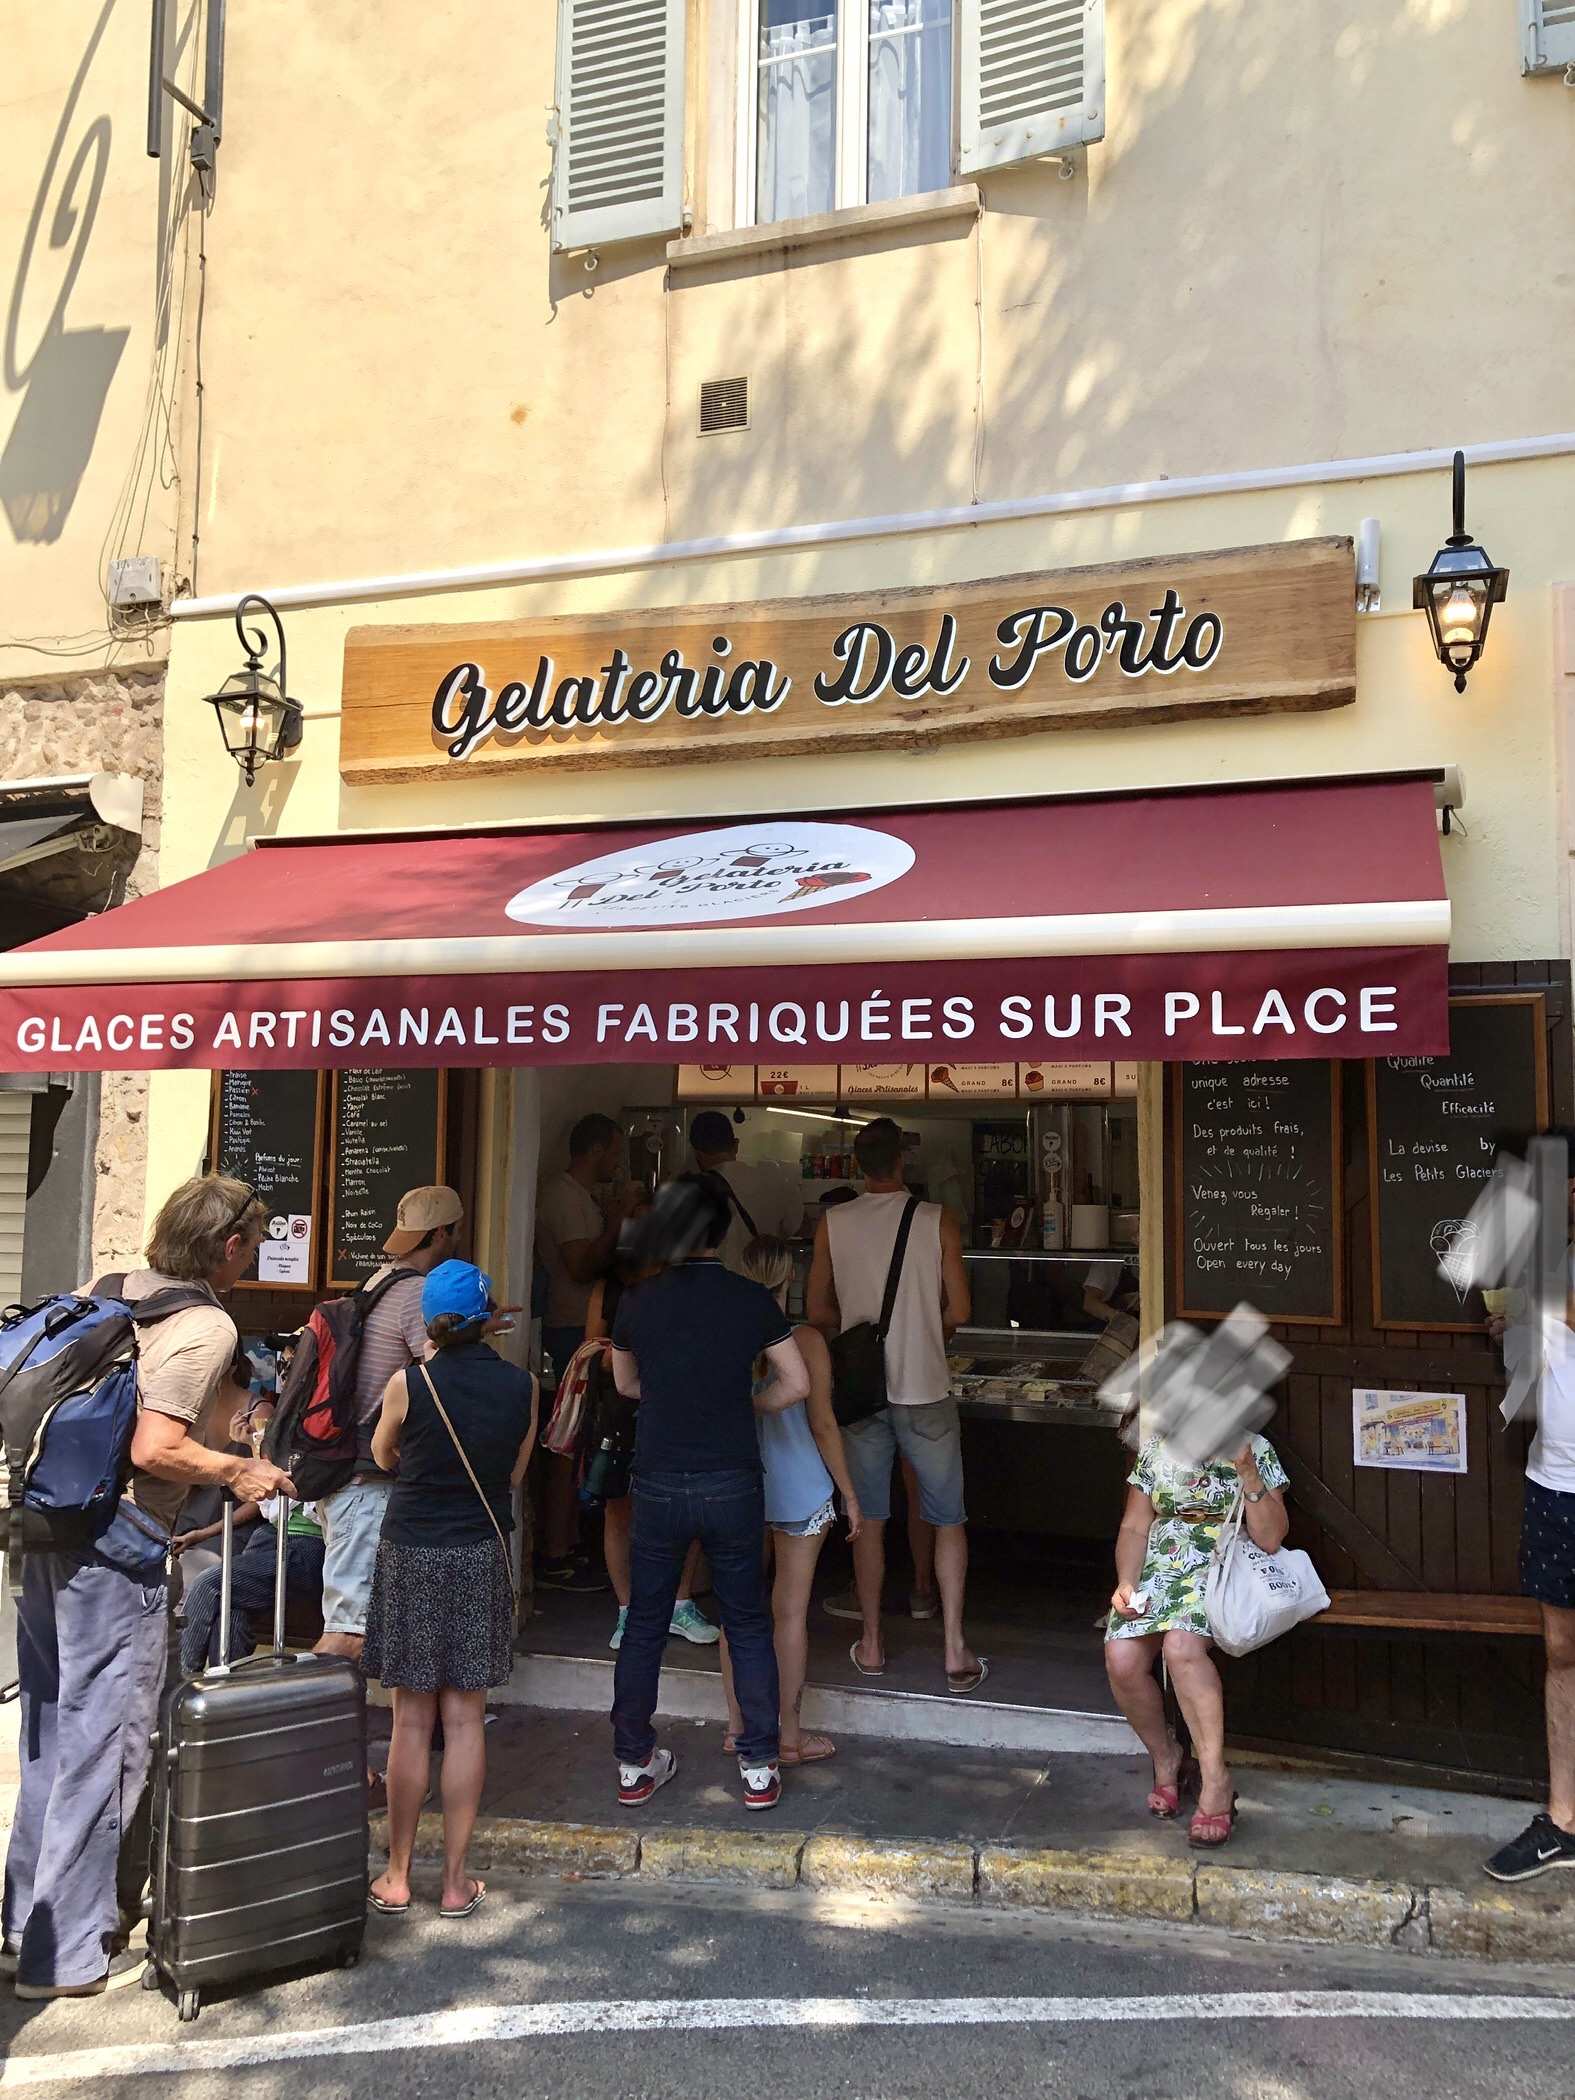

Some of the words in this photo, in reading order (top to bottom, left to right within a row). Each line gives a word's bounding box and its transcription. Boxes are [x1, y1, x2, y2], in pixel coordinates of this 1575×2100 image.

[432, 635, 790, 760] Gelateria
[814, 614, 969, 706] Del
[989, 590, 1223, 690] Porto
[659, 861, 851, 888] Gelateria
[588, 889, 663, 906] Del
[675, 879, 781, 894] Porto
[17, 1012, 195, 1053] GLACES
[212, 1003, 572, 1050] ARTISANALES
[596, 989, 975, 1046] FABRIQUÉES
[999, 993, 1131, 1040] SUR
[1164, 985, 1399, 1037] PLACE
[1192, 1076, 1228, 1092] unique
[1243, 1073, 1290, 1086] adresse
[1421, 1072, 1475, 1089] Quantité
[229, 1094, 246, 1102] Citron
[848, 1086, 872, 1095] Glaces
[874, 1085, 918, 1093] Artisanales
[1207, 1097, 1233, 1110] c'est
[1442, 1101, 1495, 1114] Efficacité
[347, 1110, 360, 1118] Café
[1193, 1124, 1214, 1138] Des
[1220, 1124, 1263, 1141] produits
[1274, 1121, 1304, 1136] frais,
[1207, 1146, 1217, 1156] et
[1224, 1145, 1235, 1156] de
[1243, 1145, 1278, 1158] qualité
[1291, 1146, 1295, 1159] !
[1389, 1139, 1405, 1155] La
[1412, 1140, 1448, 1154] devise
[1479, 1137, 1496, 1155] by
[255, 1152, 276, 1162] Parfums
[258, 1174, 274, 1182] Pêche
[274, 1174, 299, 1182] Blanche
[1383, 1168, 1402, 1182] Les
[1415, 1164, 1445, 1181] Petits
[1456, 1164, 1504, 1179] Glaciers
[345, 1188, 370, 1197] Noisette
[1191, 1185, 1228, 1205] Venez
[1232, 1188, 1258, 1199] vous
[361, 1207, 376, 1216] Raisin
[346, 1233, 376, 1243] Spéculoos
[1193, 1237, 1234, 1252] Ouvert
[1245, 1239, 1267, 1251] tous
[1274, 1238, 1289, 1252] les
[1294, 1240, 1322, 1257] jours
[1196, 1256, 1226, 1274] Open
[1236, 1258, 1266, 1275] every
[1271, 1258, 1292, 1280] day
